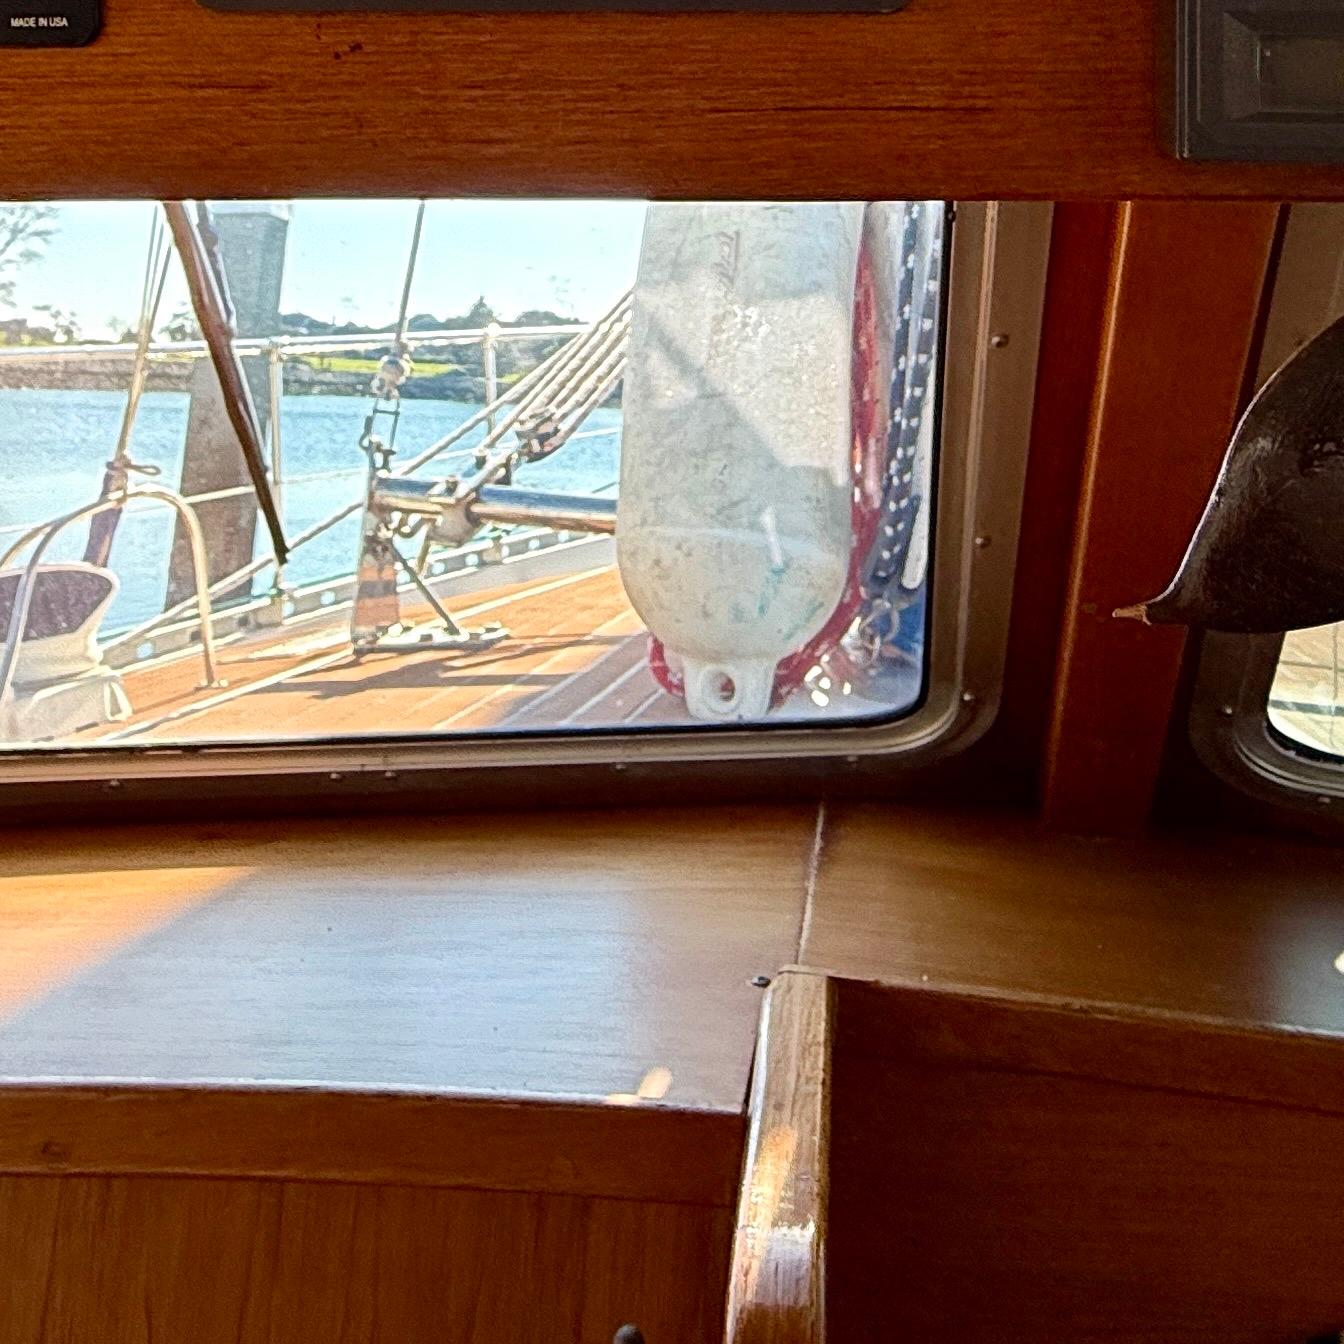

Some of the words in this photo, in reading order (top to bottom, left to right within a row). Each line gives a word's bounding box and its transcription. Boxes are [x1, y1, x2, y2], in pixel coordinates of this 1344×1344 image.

[10, 17, 36, 28] MADE
[38, 17, 47, 28] IN
[49, 17, 68, 28] USA
